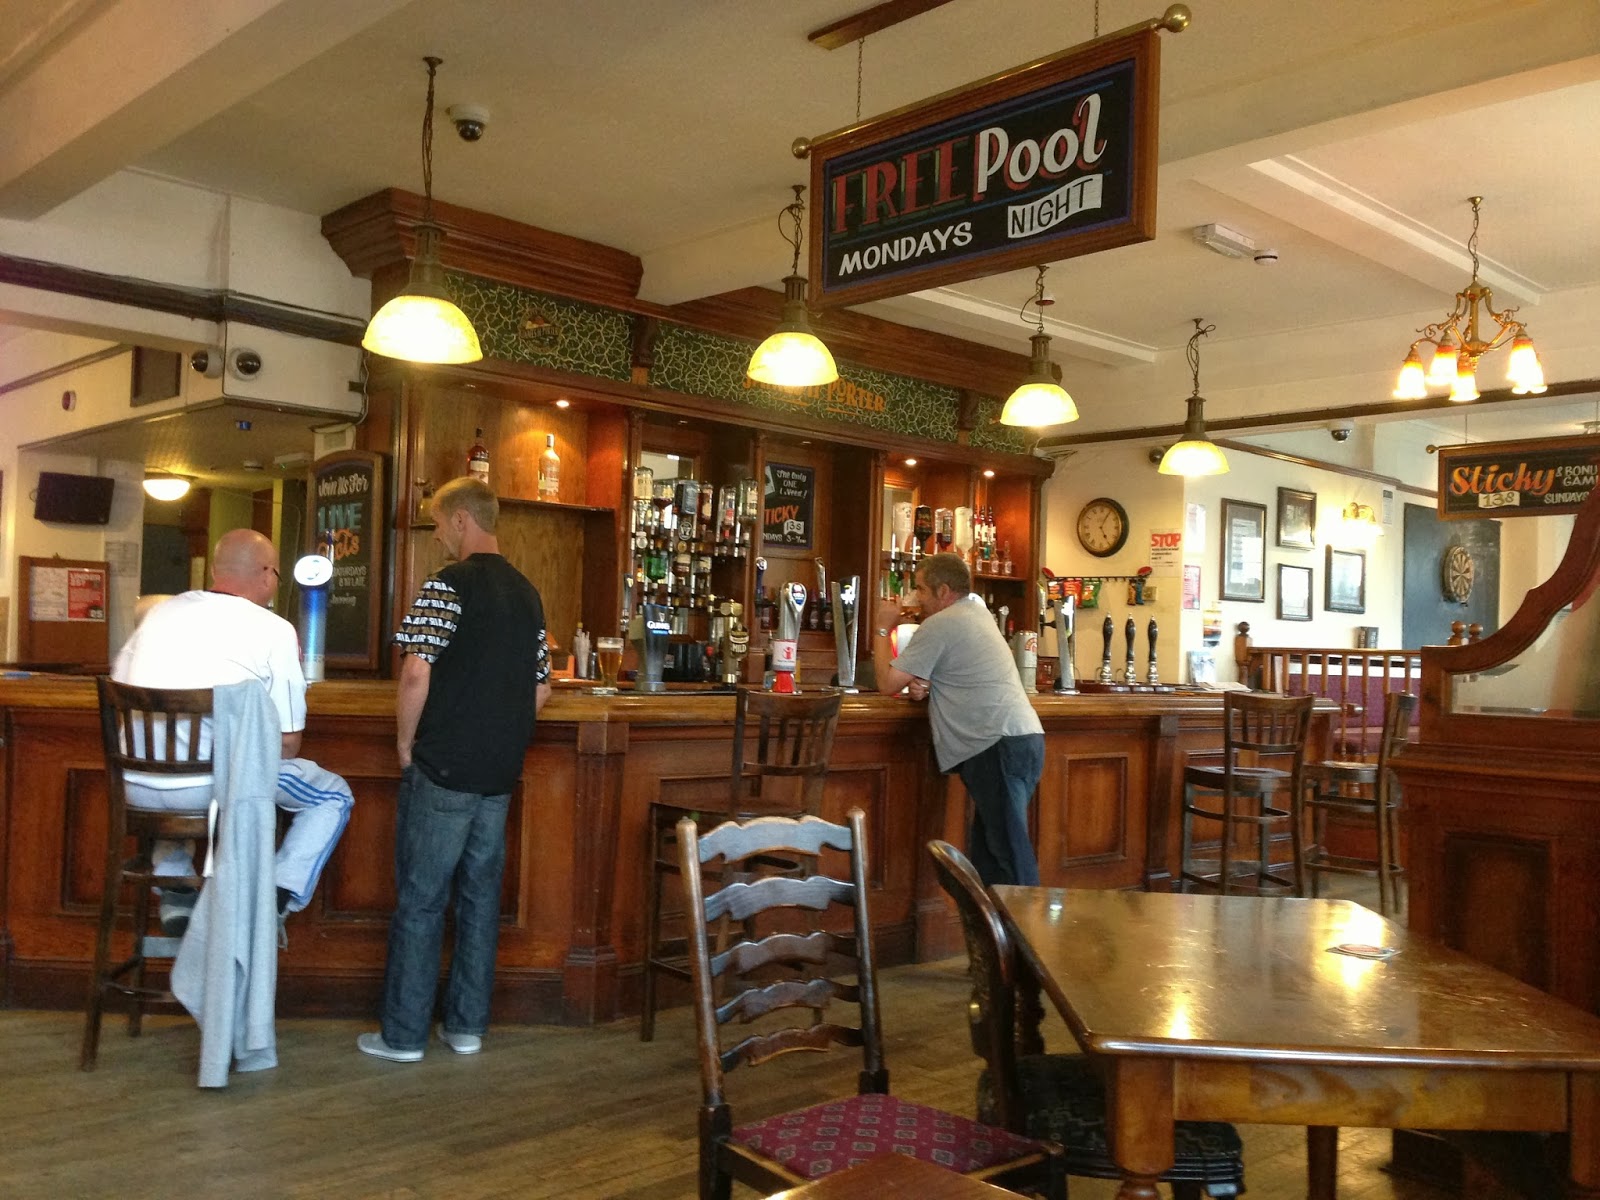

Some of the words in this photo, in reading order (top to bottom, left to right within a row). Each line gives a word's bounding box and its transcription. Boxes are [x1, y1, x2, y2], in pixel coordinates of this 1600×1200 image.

[831, 136, 969, 236] FREE
[974, 93, 1107, 198] Pool
[1011, 177, 1094, 236] NIGHT
[838, 221, 973, 276] MONDAYS
[1450, 463, 1555, 496] Sticky
[1555, 466, 1563, 477] &
[1565, 464, 1598, 476] BONU
[783, 480, 797, 489] ONE
[1563, 475, 1599, 487] GAM
[318, 502, 363, 533] LIVE
[764, 505, 799, 525] TICKY
[763, 532, 783, 542] NDAYS
[1151, 532, 1182, 548] STOP
